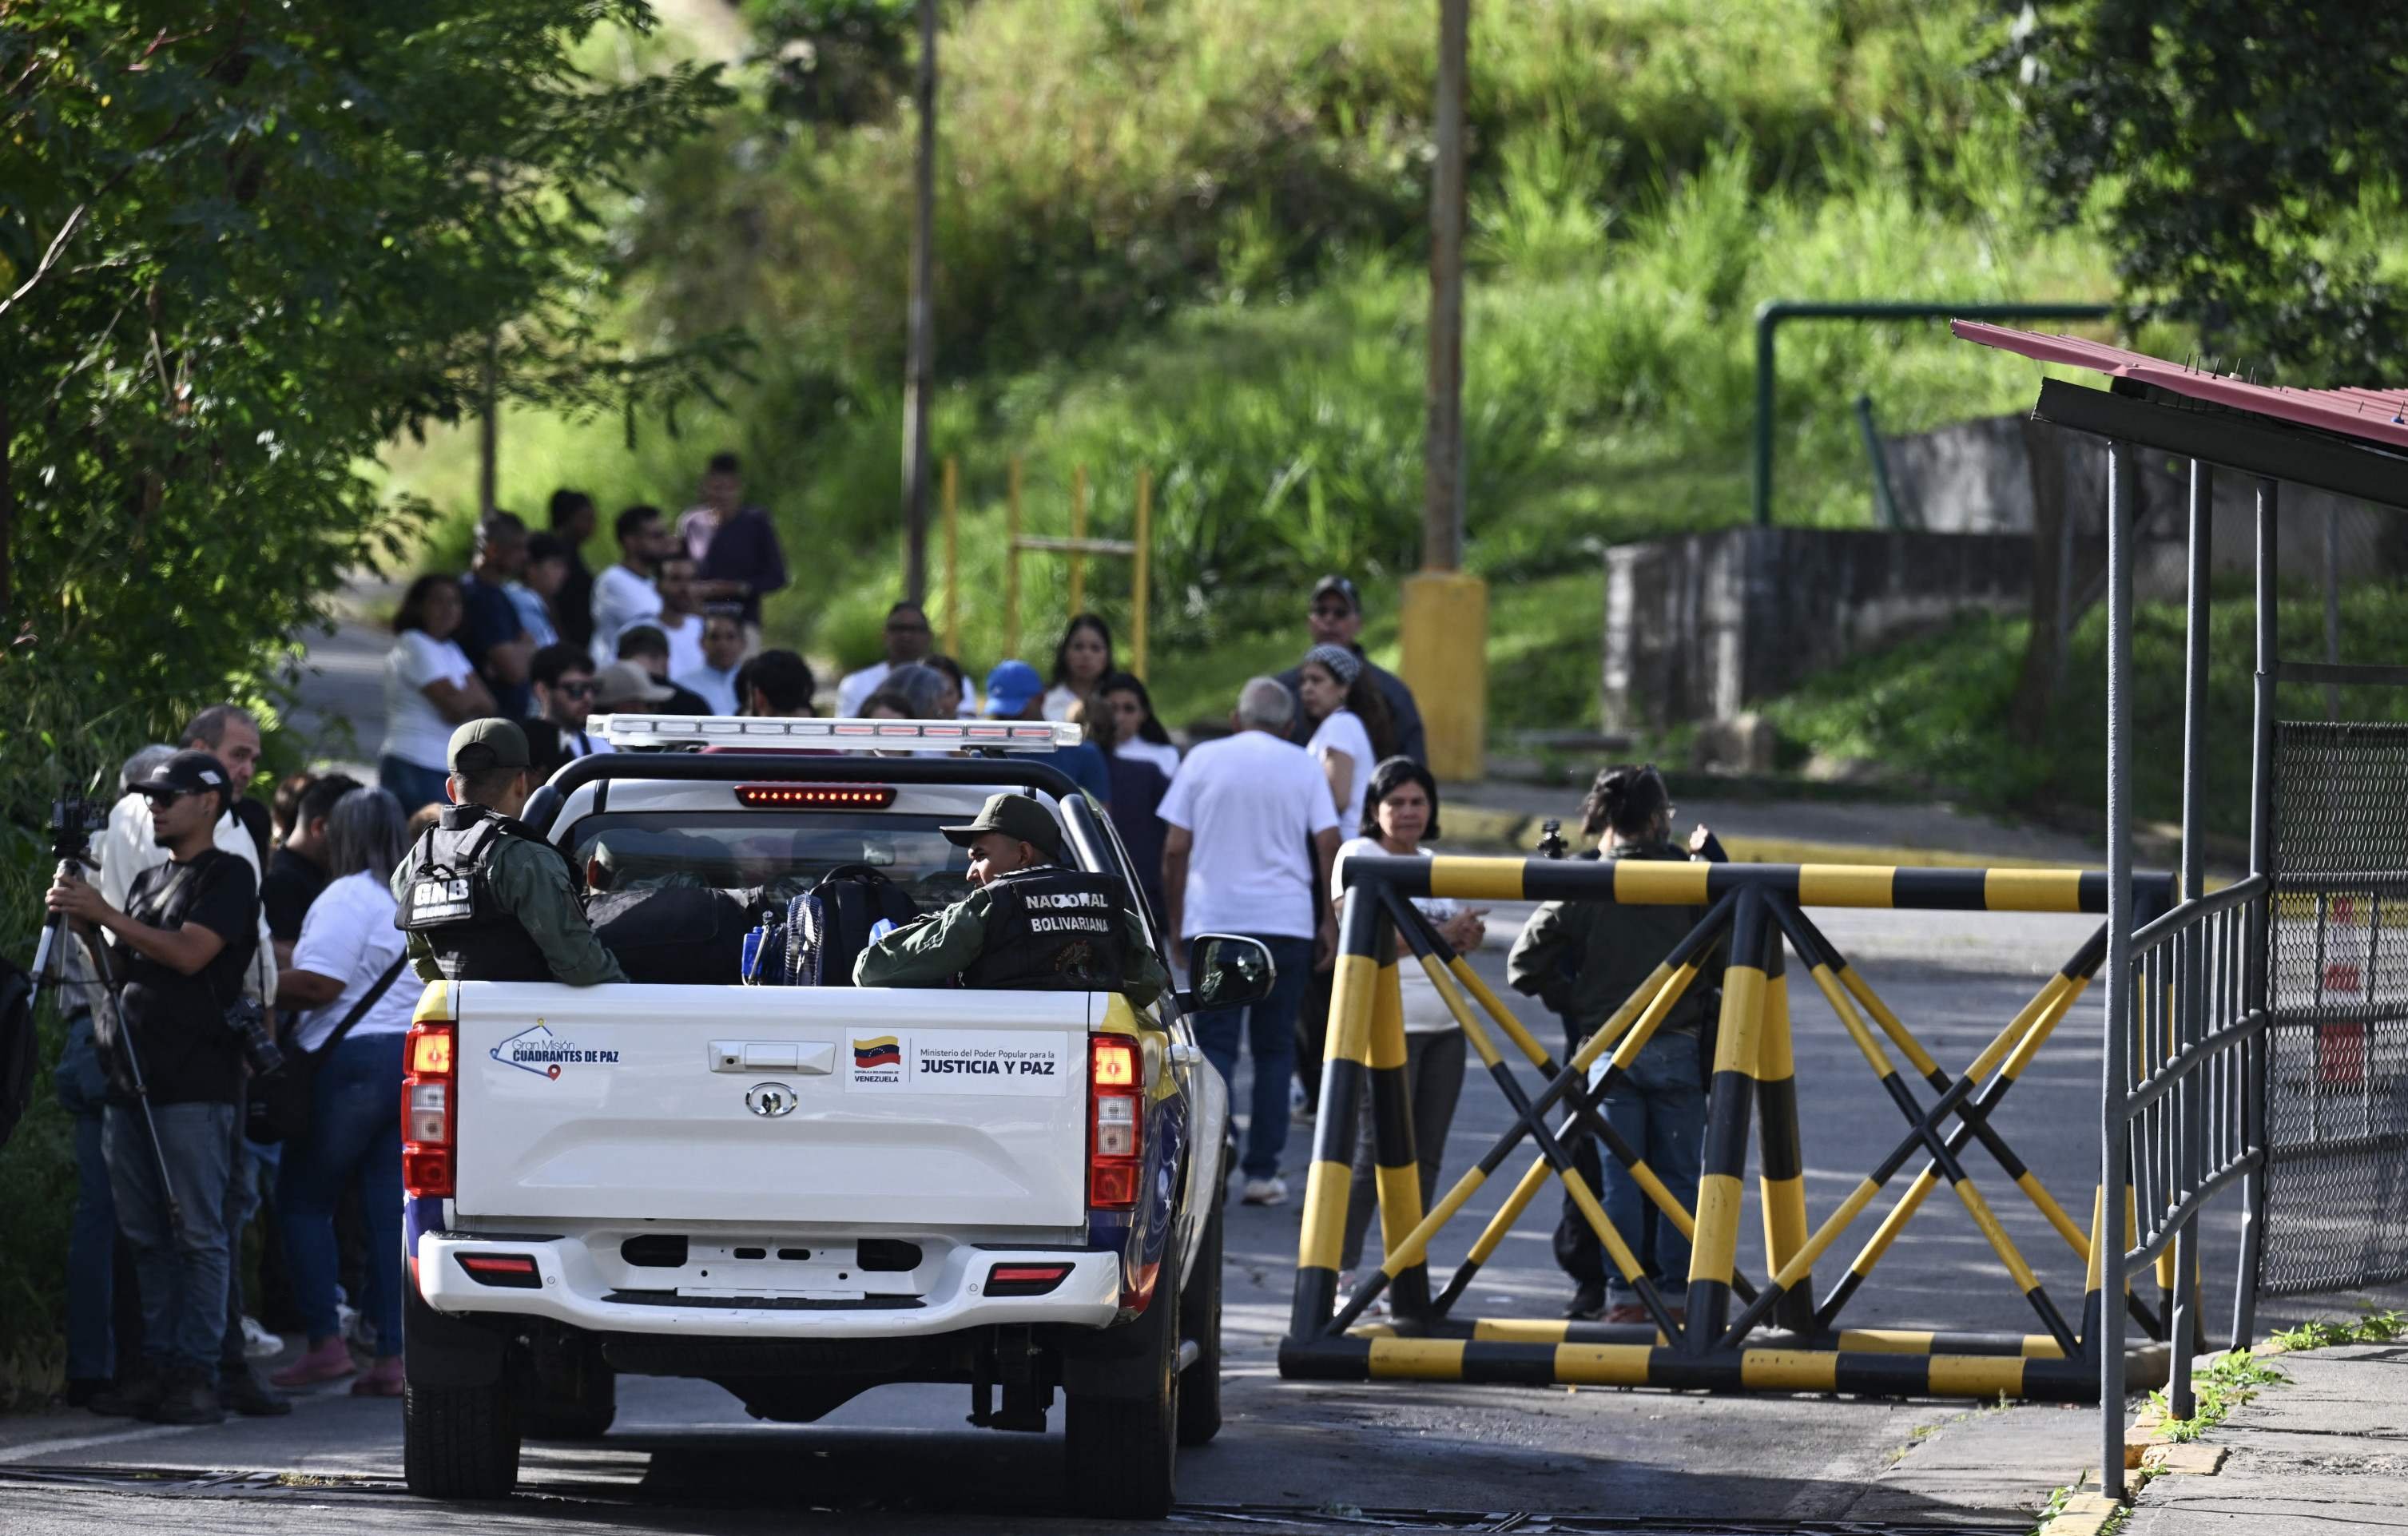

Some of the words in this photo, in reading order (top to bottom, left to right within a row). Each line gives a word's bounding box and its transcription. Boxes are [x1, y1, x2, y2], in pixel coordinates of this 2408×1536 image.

[413, 879, 469, 906] GNB
[1025, 892, 1108, 909] NACONAL
[1031, 916, 1109, 932] BOLIVARIANA
[512, 1038, 540, 1050] Gran
[542, 1039, 575, 1050] Misión
[512, 1050, 582, 1062] CUADRANTES
[584, 1050, 598, 1062] DE
[600, 1050, 619, 1063] PAZ
[960, 1049, 972, 1058] del
[999, 1050, 1027, 1060] Popular
[1029, 1051, 1047, 1060] para
[1048, 1050, 1055, 1059] la
[920, 1059, 999, 1074] JUSTICIA
[1004, 1061, 1016, 1074] Y
[1020, 1061, 1055, 1075] PAZ
